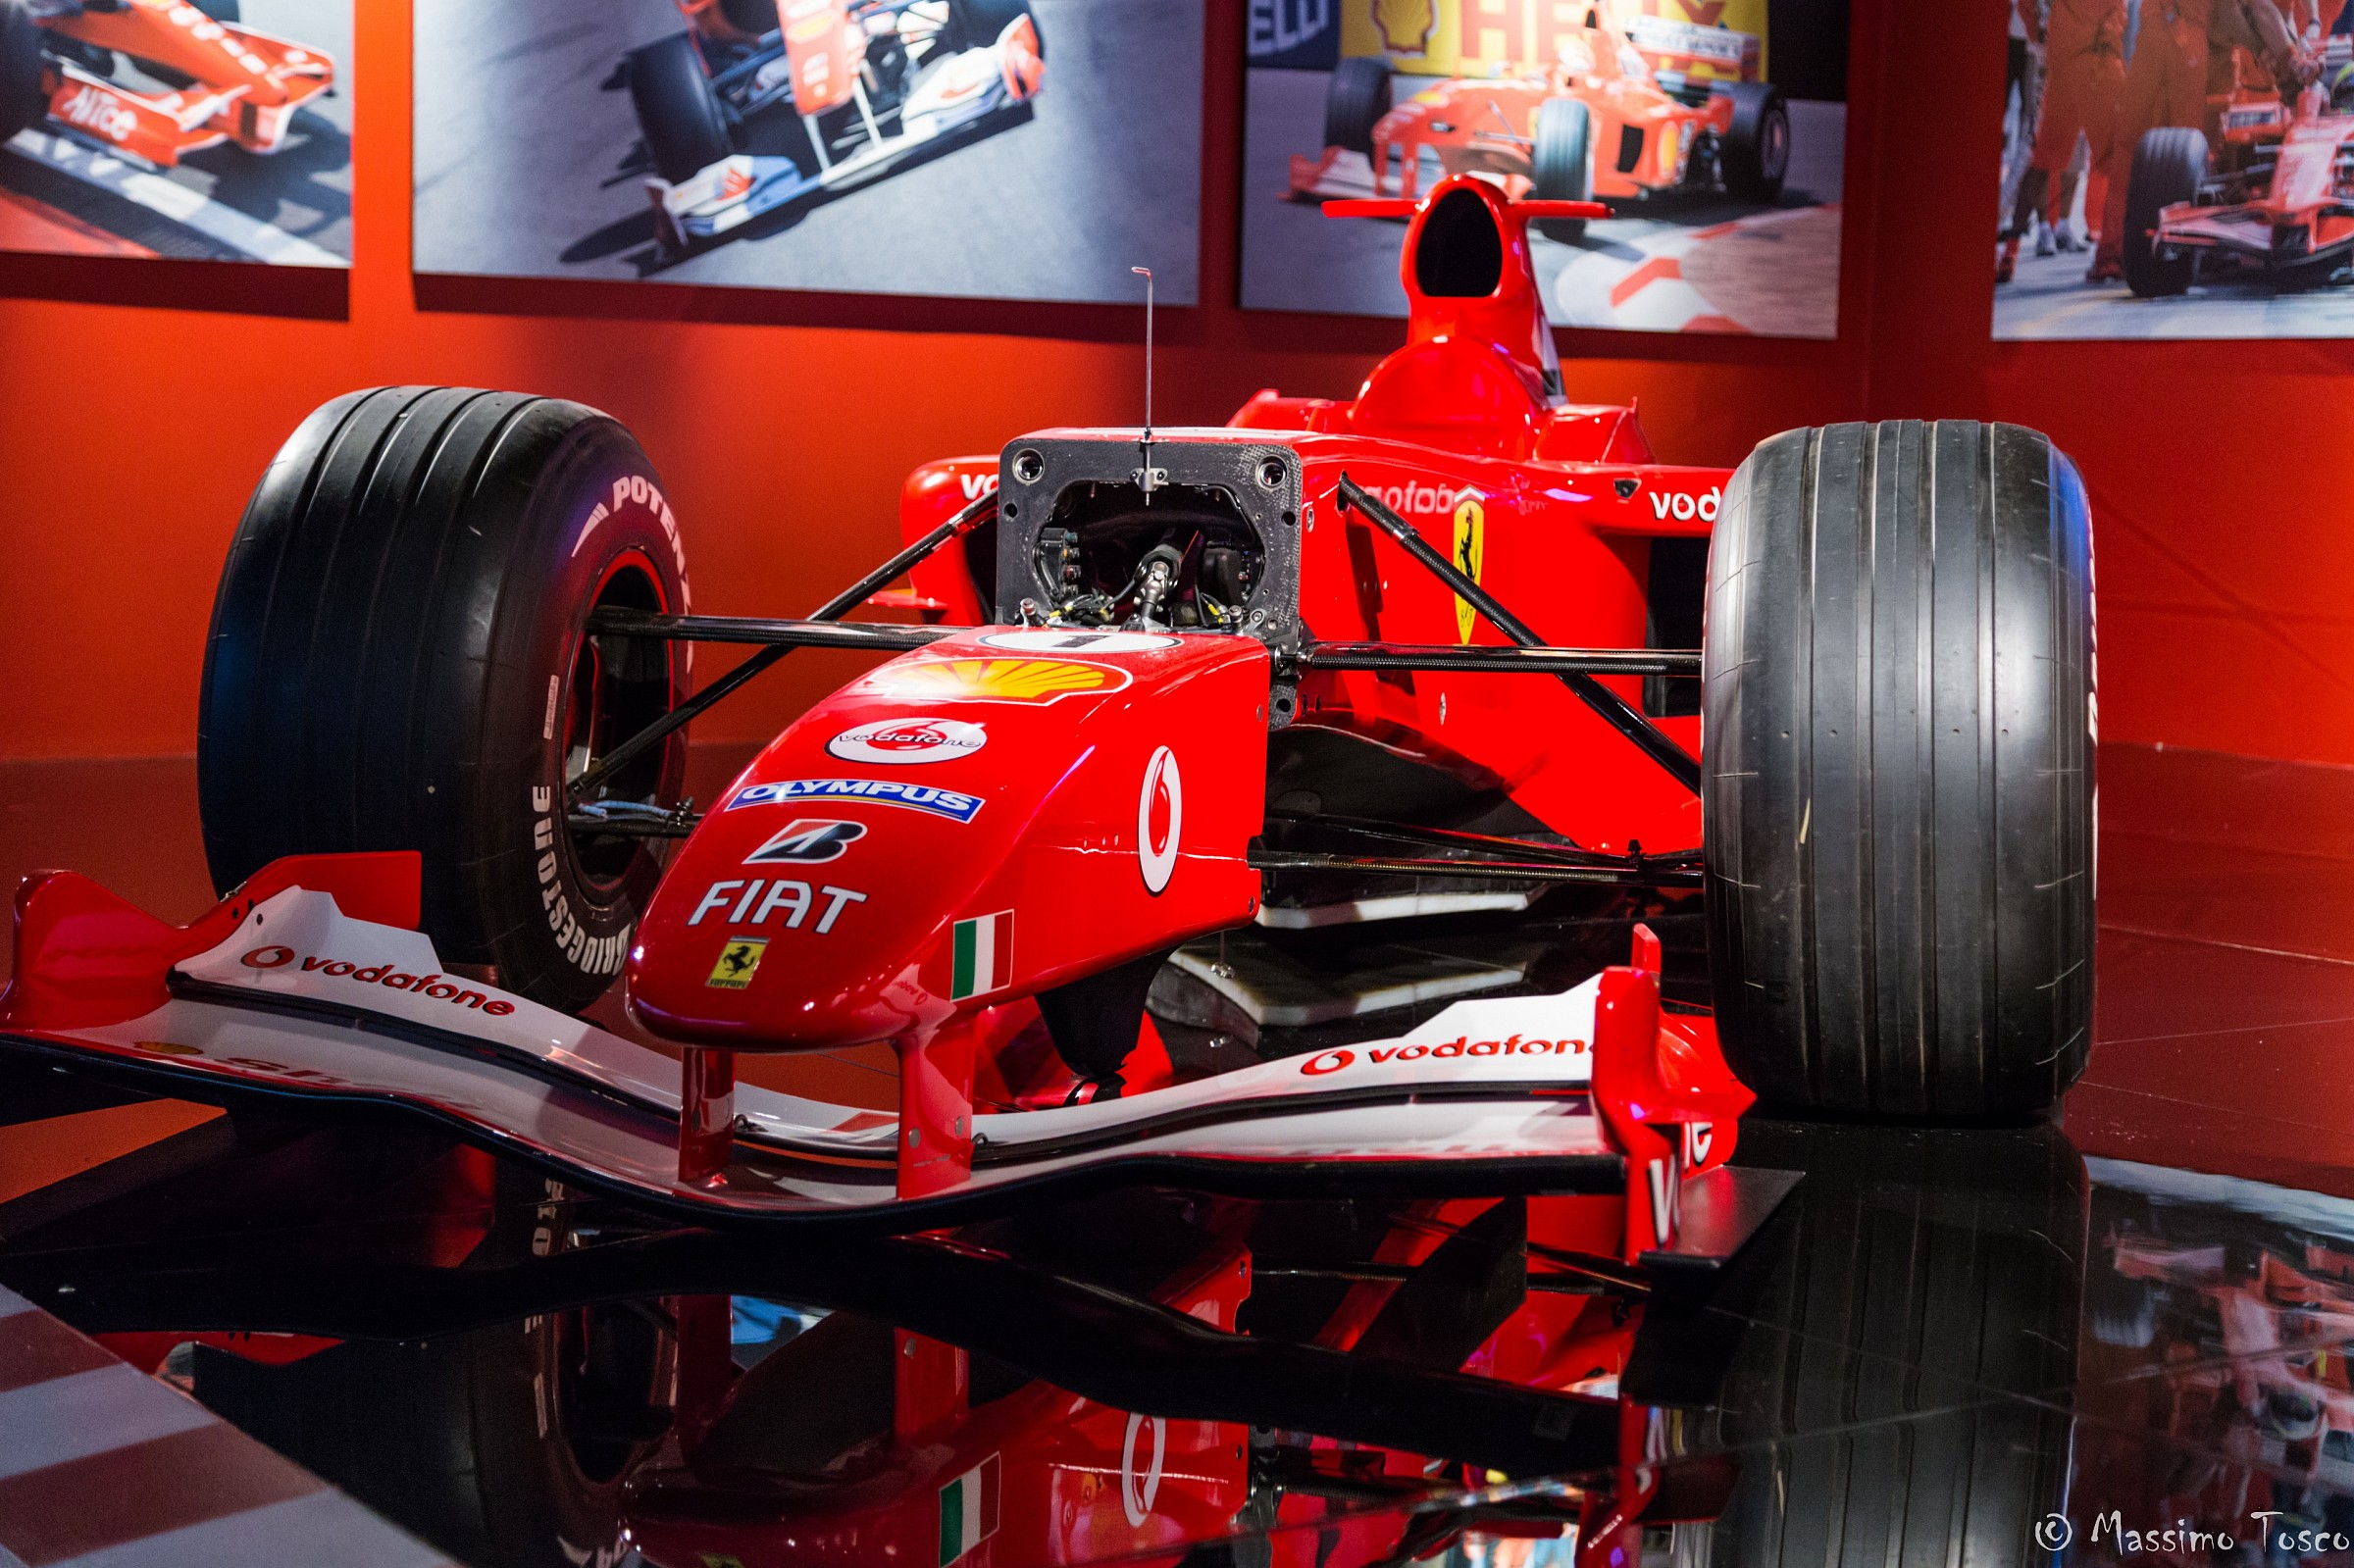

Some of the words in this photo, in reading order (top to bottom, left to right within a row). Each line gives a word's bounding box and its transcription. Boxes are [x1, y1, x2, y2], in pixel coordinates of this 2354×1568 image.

[839, 730, 983, 748] vodafone
[742, 781, 971, 812] OLYMPUS
[687, 879, 868, 934] FIAT
[300, 955, 516, 1016] vodafone
[1368, 1034, 1593, 1064] vodafon
